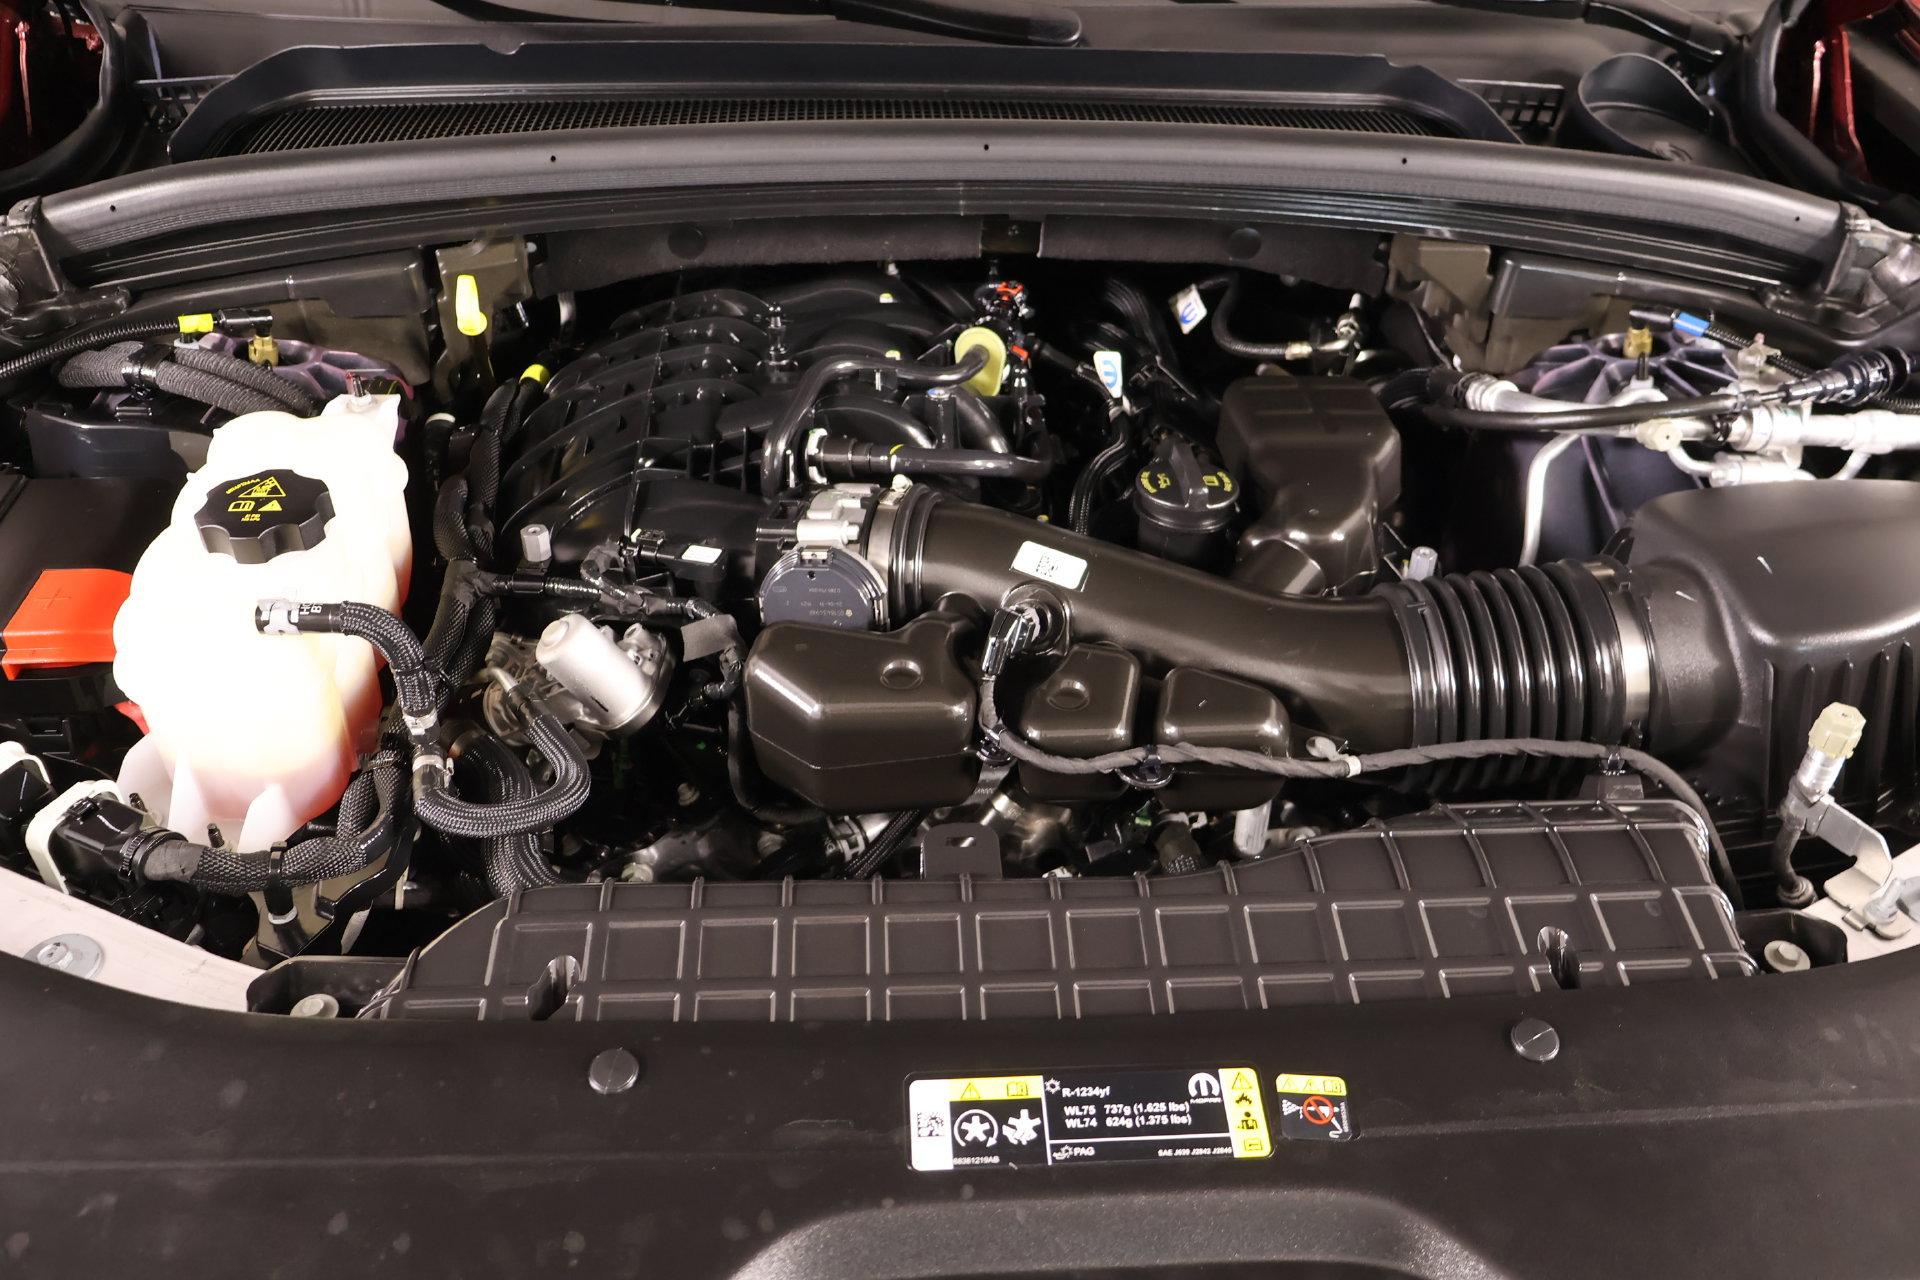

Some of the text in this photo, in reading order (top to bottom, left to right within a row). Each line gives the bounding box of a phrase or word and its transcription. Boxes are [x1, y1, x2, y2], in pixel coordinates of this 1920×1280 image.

[1062, 1086, 1110, 1098] R-1234yf
[1063, 1101, 1190, 1116] WL75 737g (1.625 lbs)
[1065, 1113, 1192, 1129] WL74 624g (1.375 lbs)
[1073, 1146, 1095, 1156] PAG
[1157, 1149, 1173, 1157] SAE
